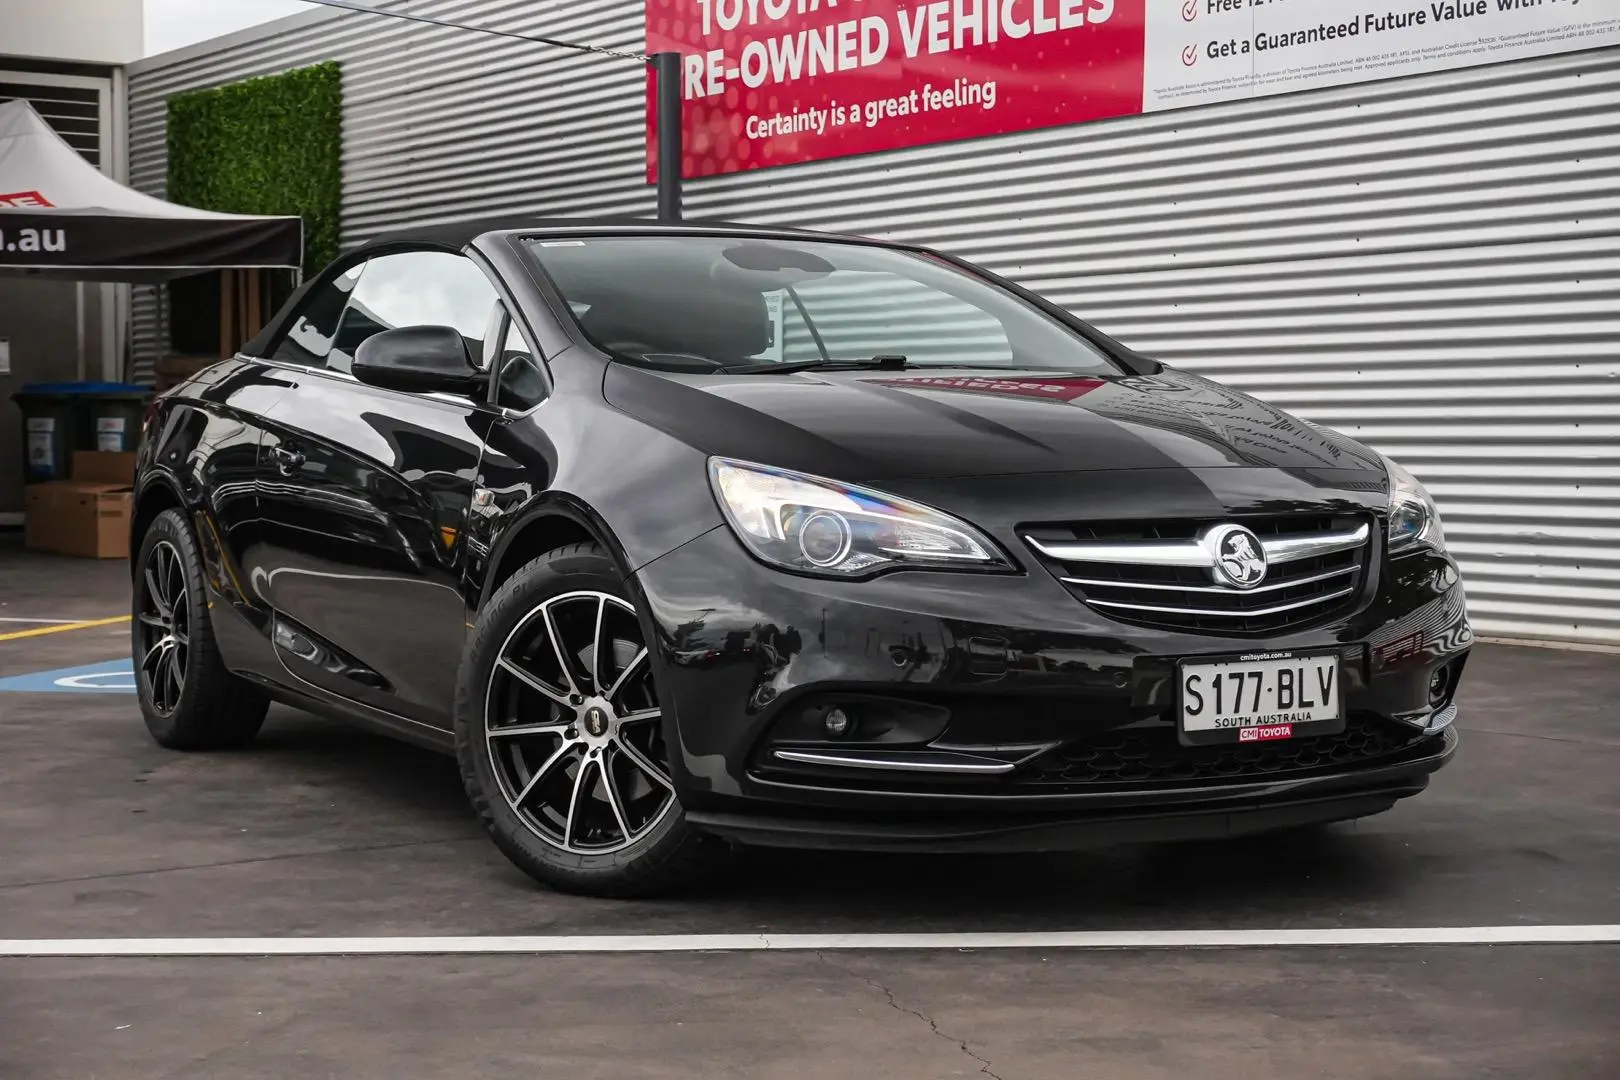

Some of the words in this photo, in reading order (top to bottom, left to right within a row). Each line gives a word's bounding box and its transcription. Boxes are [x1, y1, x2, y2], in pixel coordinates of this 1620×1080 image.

[697, 0, 837, 35] TOYO
[1207, 0, 1241, 14] Free
[1206, 39, 1236, 59] Get
[1241, 40, 1250, 54] a
[1255, 15, 1359, 51] Guaranteed
[1364, 10, 1427, 34] Future
[1431, 0, 1487, 22] Value
[682, 15, 889, 100] RE-OWNED
[897, 0, 1115, 58] VEHICLES
[746, 106, 827, 139] Certainty
[831, 100, 845, 126] is
[849, 104, 861, 123] a
[865, 90, 919, 128] great
[922, 78, 996, 111] feeling
[1240, 652, 1292, 661] cmitoyota.com.au
[1215, 716, 1251, 728] SOUTH
[1256, 712, 1312, 724] AUSTRALIA
[1241, 730, 1257, 739] CMI
[1259, 727, 1291, 737] TOYOTA
